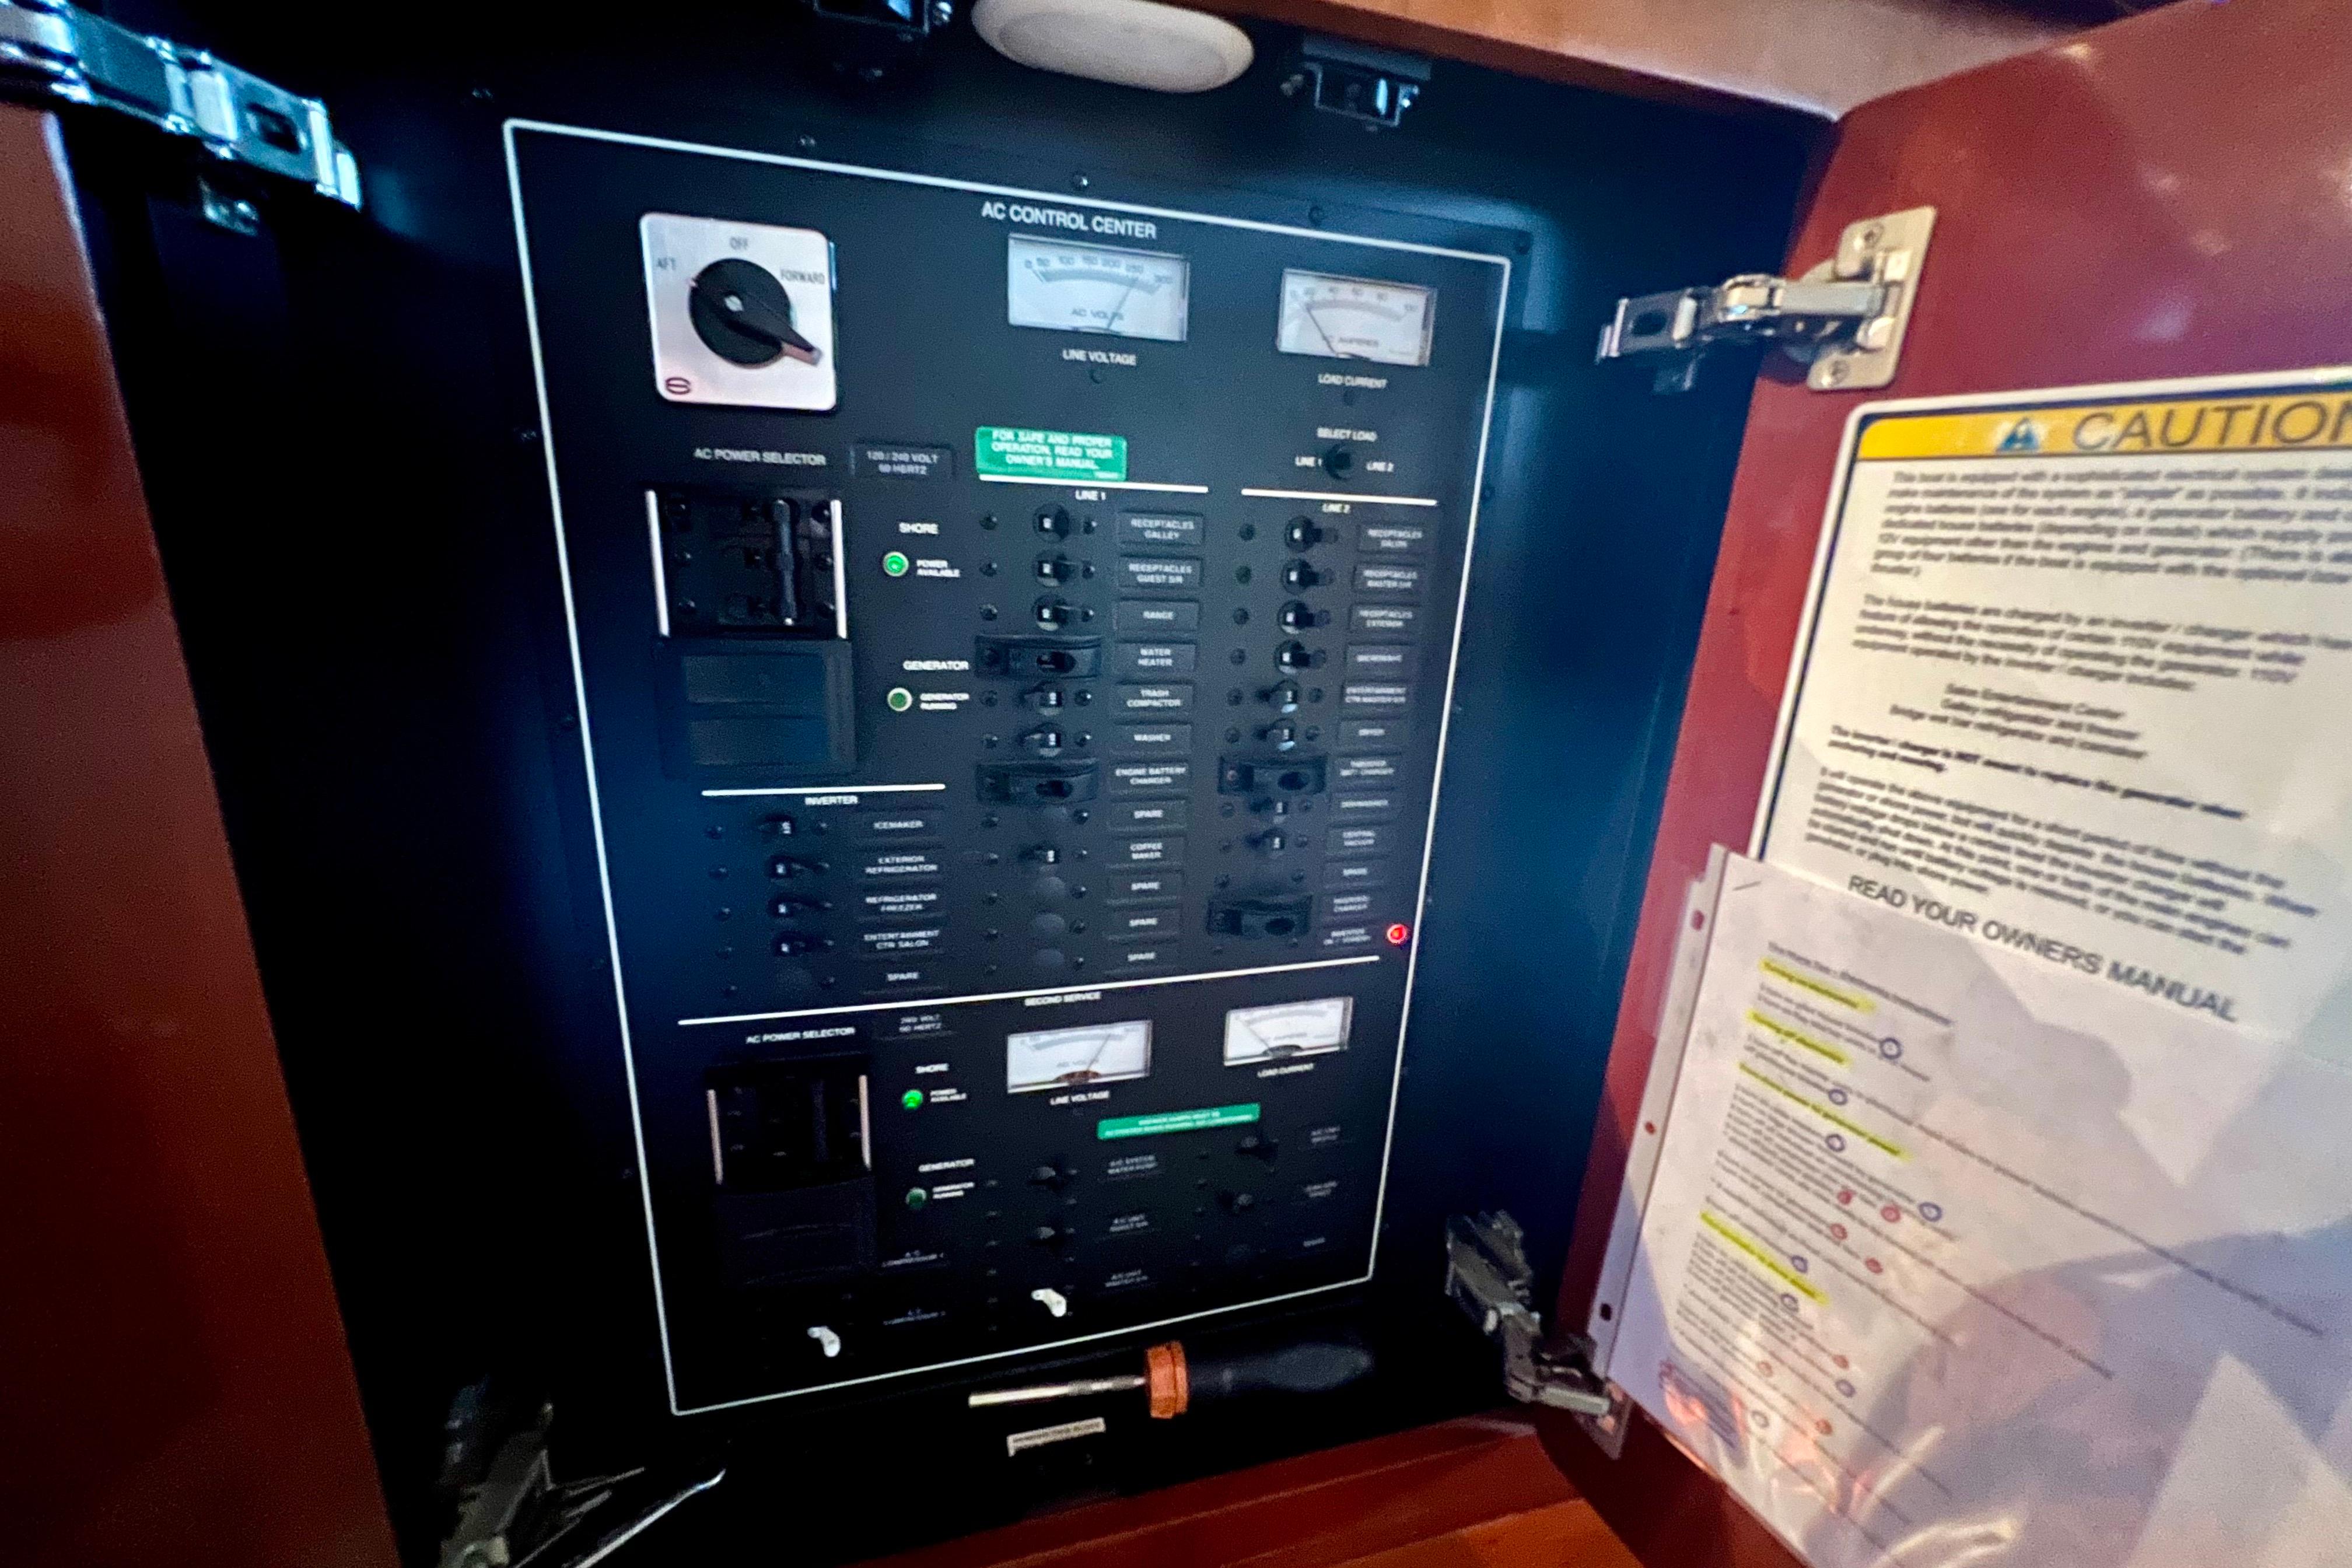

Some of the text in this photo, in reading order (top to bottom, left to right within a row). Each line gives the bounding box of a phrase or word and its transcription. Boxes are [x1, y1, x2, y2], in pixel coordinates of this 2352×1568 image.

[981, 201, 1157, 240] AC CONTROL CENTER
[730, 237, 748, 251] OFF
[657, 257, 677, 271] AFT
[780, 269, 825, 285] FORWARD
[1062, 349, 1137, 366] LINE VOLTAGE
[992, 430, 1113, 448] FOR SAFE AND PROPER
[694, 449, 826, 466] AC POWER SELECTOR
[1054, 444, 1083, 457] READ
[1086, 447, 1113, 459] YOUR
[911, 453, 938, 464] VOLT
[1295, 456, 1315, 467] LINE
[1075, 489, 1098, 501] LINE
[899, 522, 939, 535] SHORE
[1130, 518, 1195, 531] RECEPTACLES
[1144, 530, 1180, 540] GALLEY
[1129, 563, 1192, 574] RECEPTACLES
[903, 660, 969, 671] GENERATOR
[804, 795, 859, 806] INVERTER
[1133, 809, 1164, 819] SPARE
[1130, 881, 1160, 891] SPARE
[1129, 918, 1158, 928] SPARE
[1848, 874, 2238, 1023] READ YOUR OWNERS MANUAL
[1127, 952, 1156, 962] SPARE
[887, 971, 920, 982] SPARE
[746, 1027, 856, 1044] AC POWER SELECTOR
